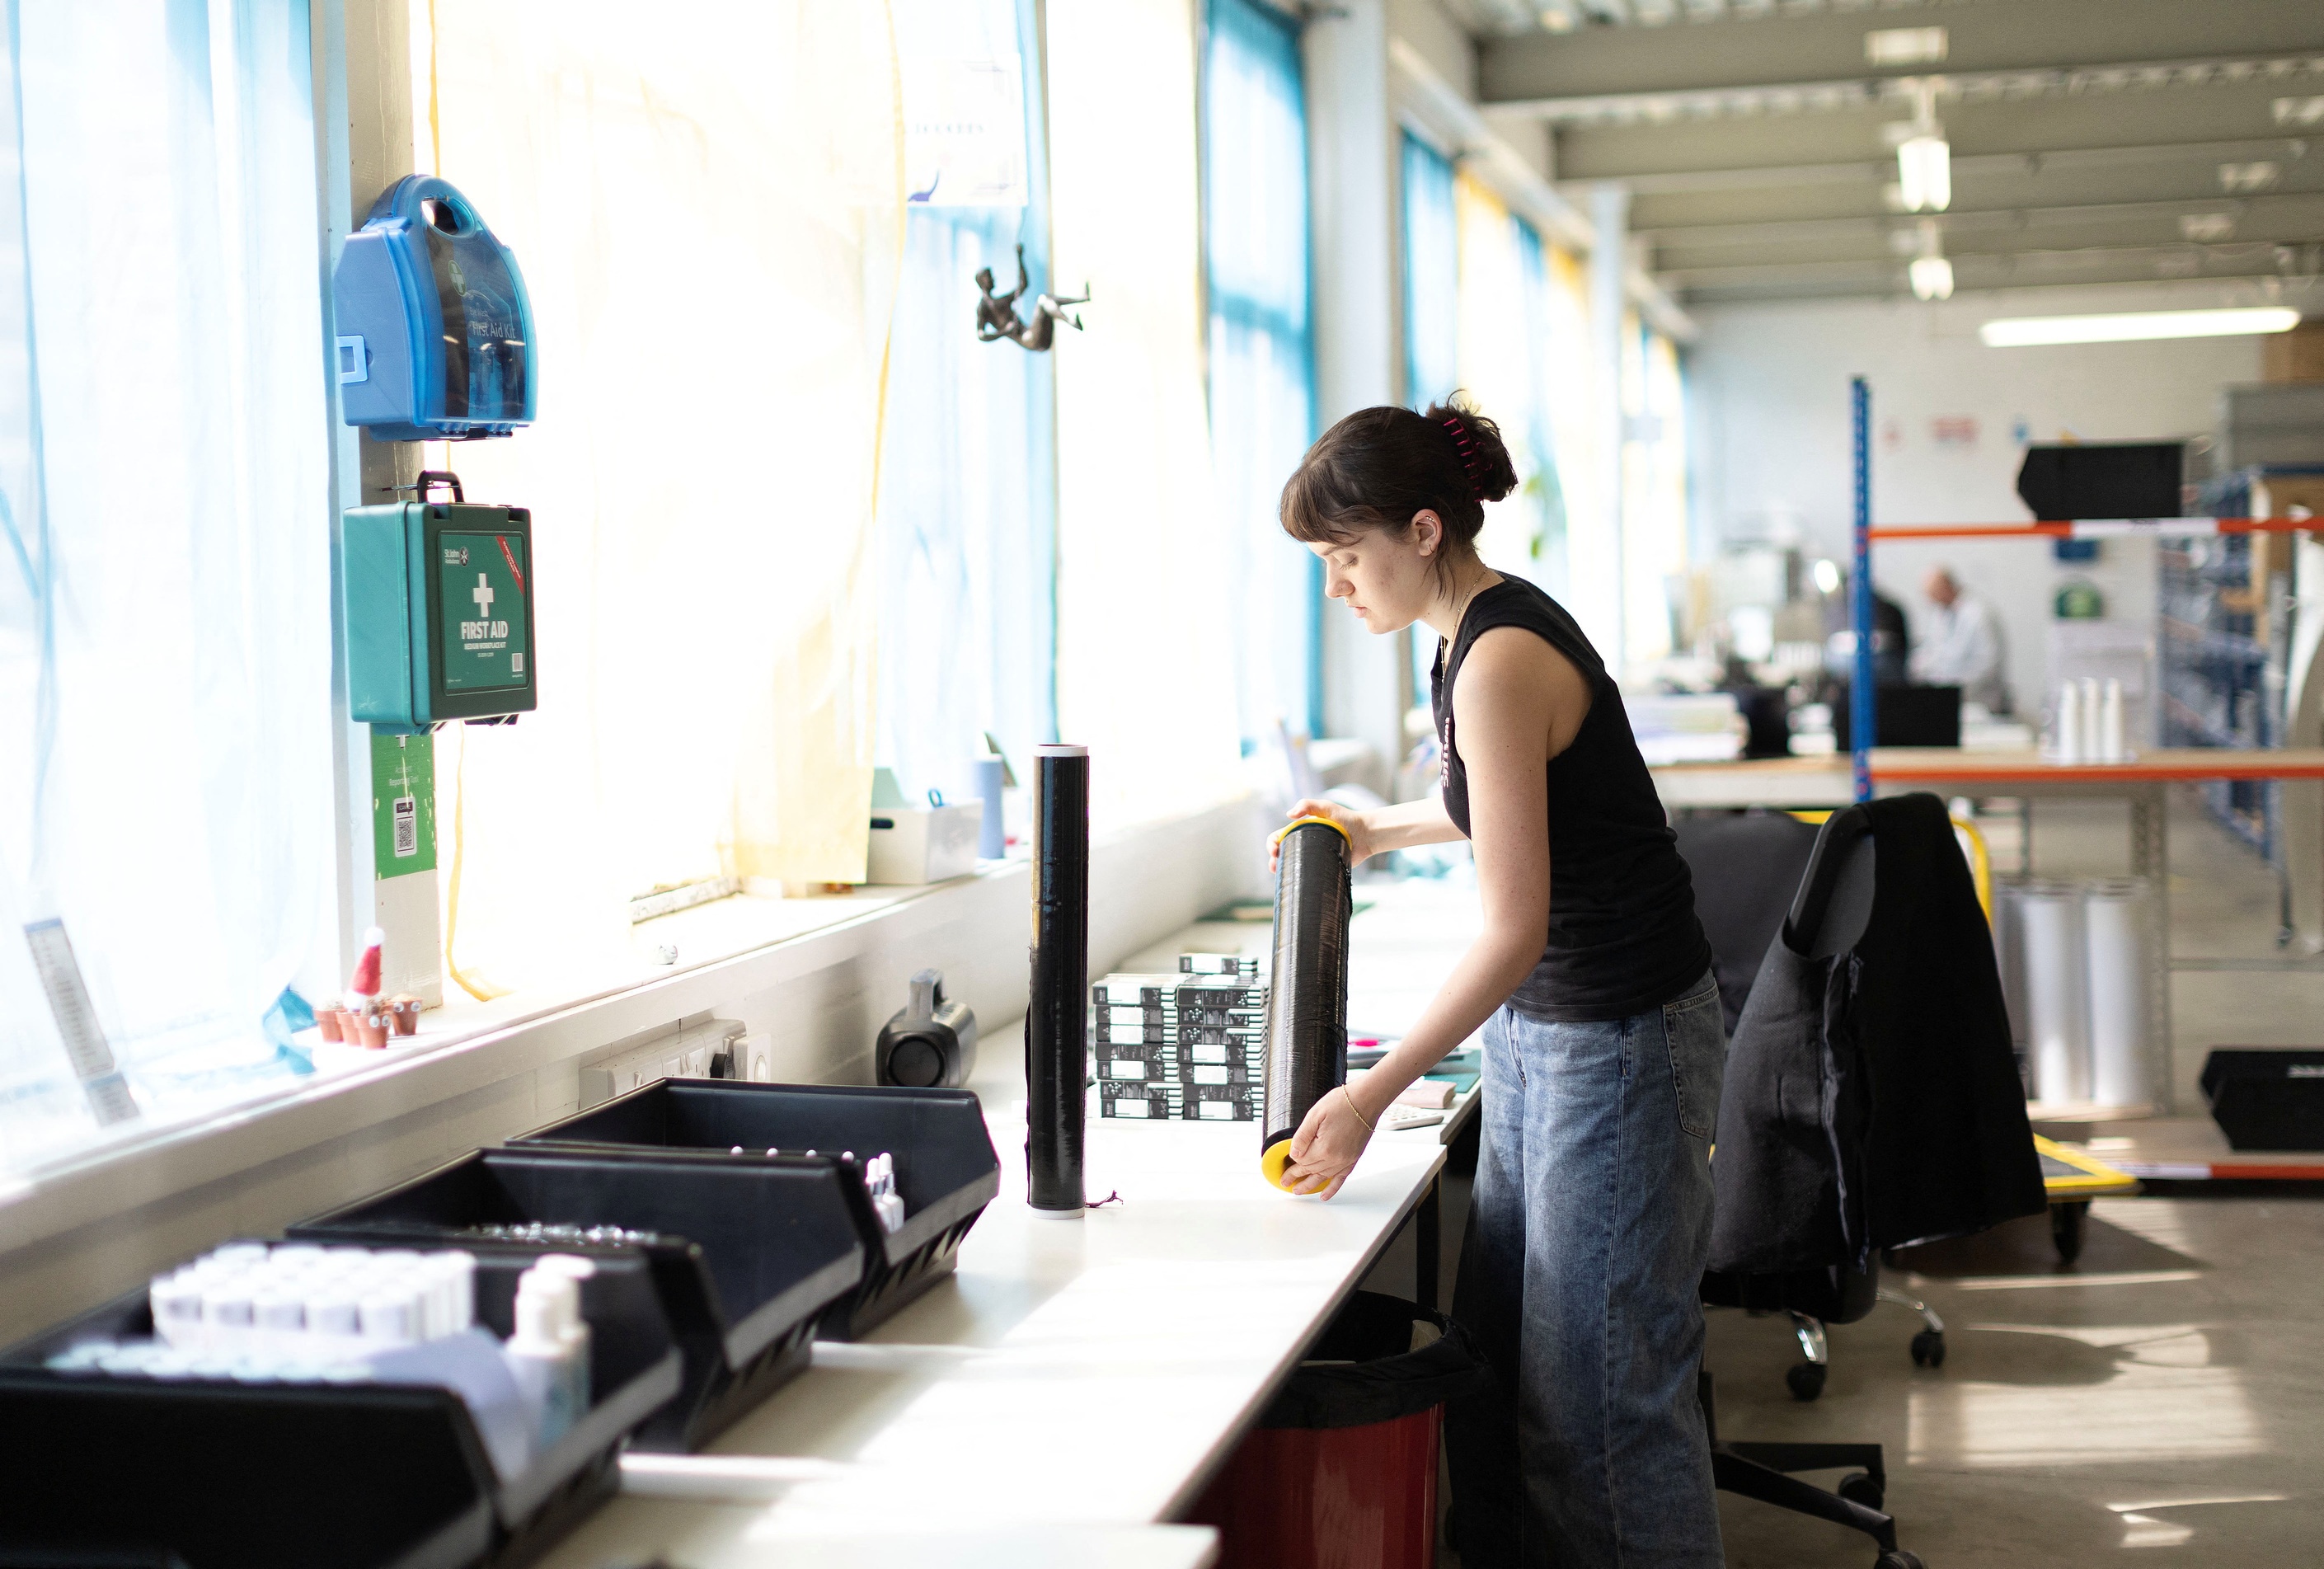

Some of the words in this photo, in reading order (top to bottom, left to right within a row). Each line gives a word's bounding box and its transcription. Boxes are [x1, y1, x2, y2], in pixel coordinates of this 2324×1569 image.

[490, 322, 503, 338] Aid
[504, 323, 516, 339] Kit
[461, 621, 489, 640] FIRST
[490, 620, 509, 639] AID
